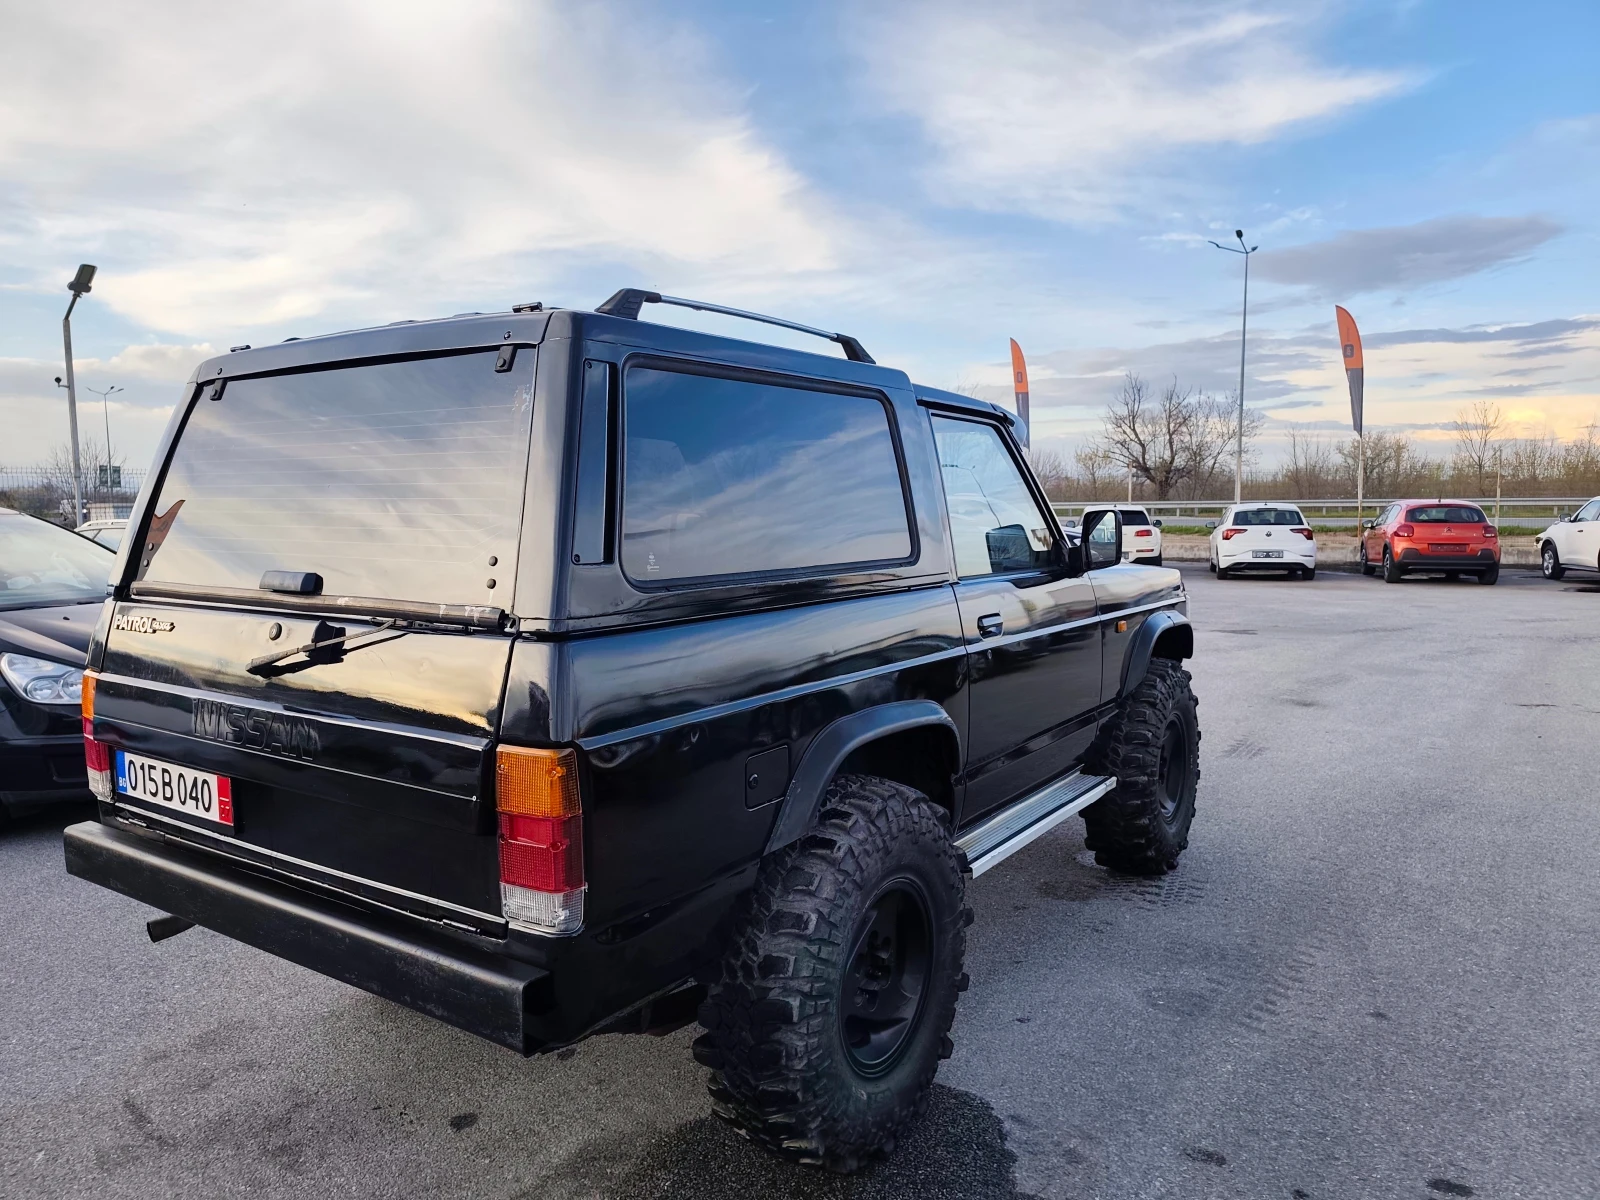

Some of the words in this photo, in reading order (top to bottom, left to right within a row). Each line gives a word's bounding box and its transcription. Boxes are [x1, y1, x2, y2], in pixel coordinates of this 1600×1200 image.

[114, 615, 155, 634] PATROL
[192, 698, 318, 761] NISSAN
[119, 776, 127, 787] BG
